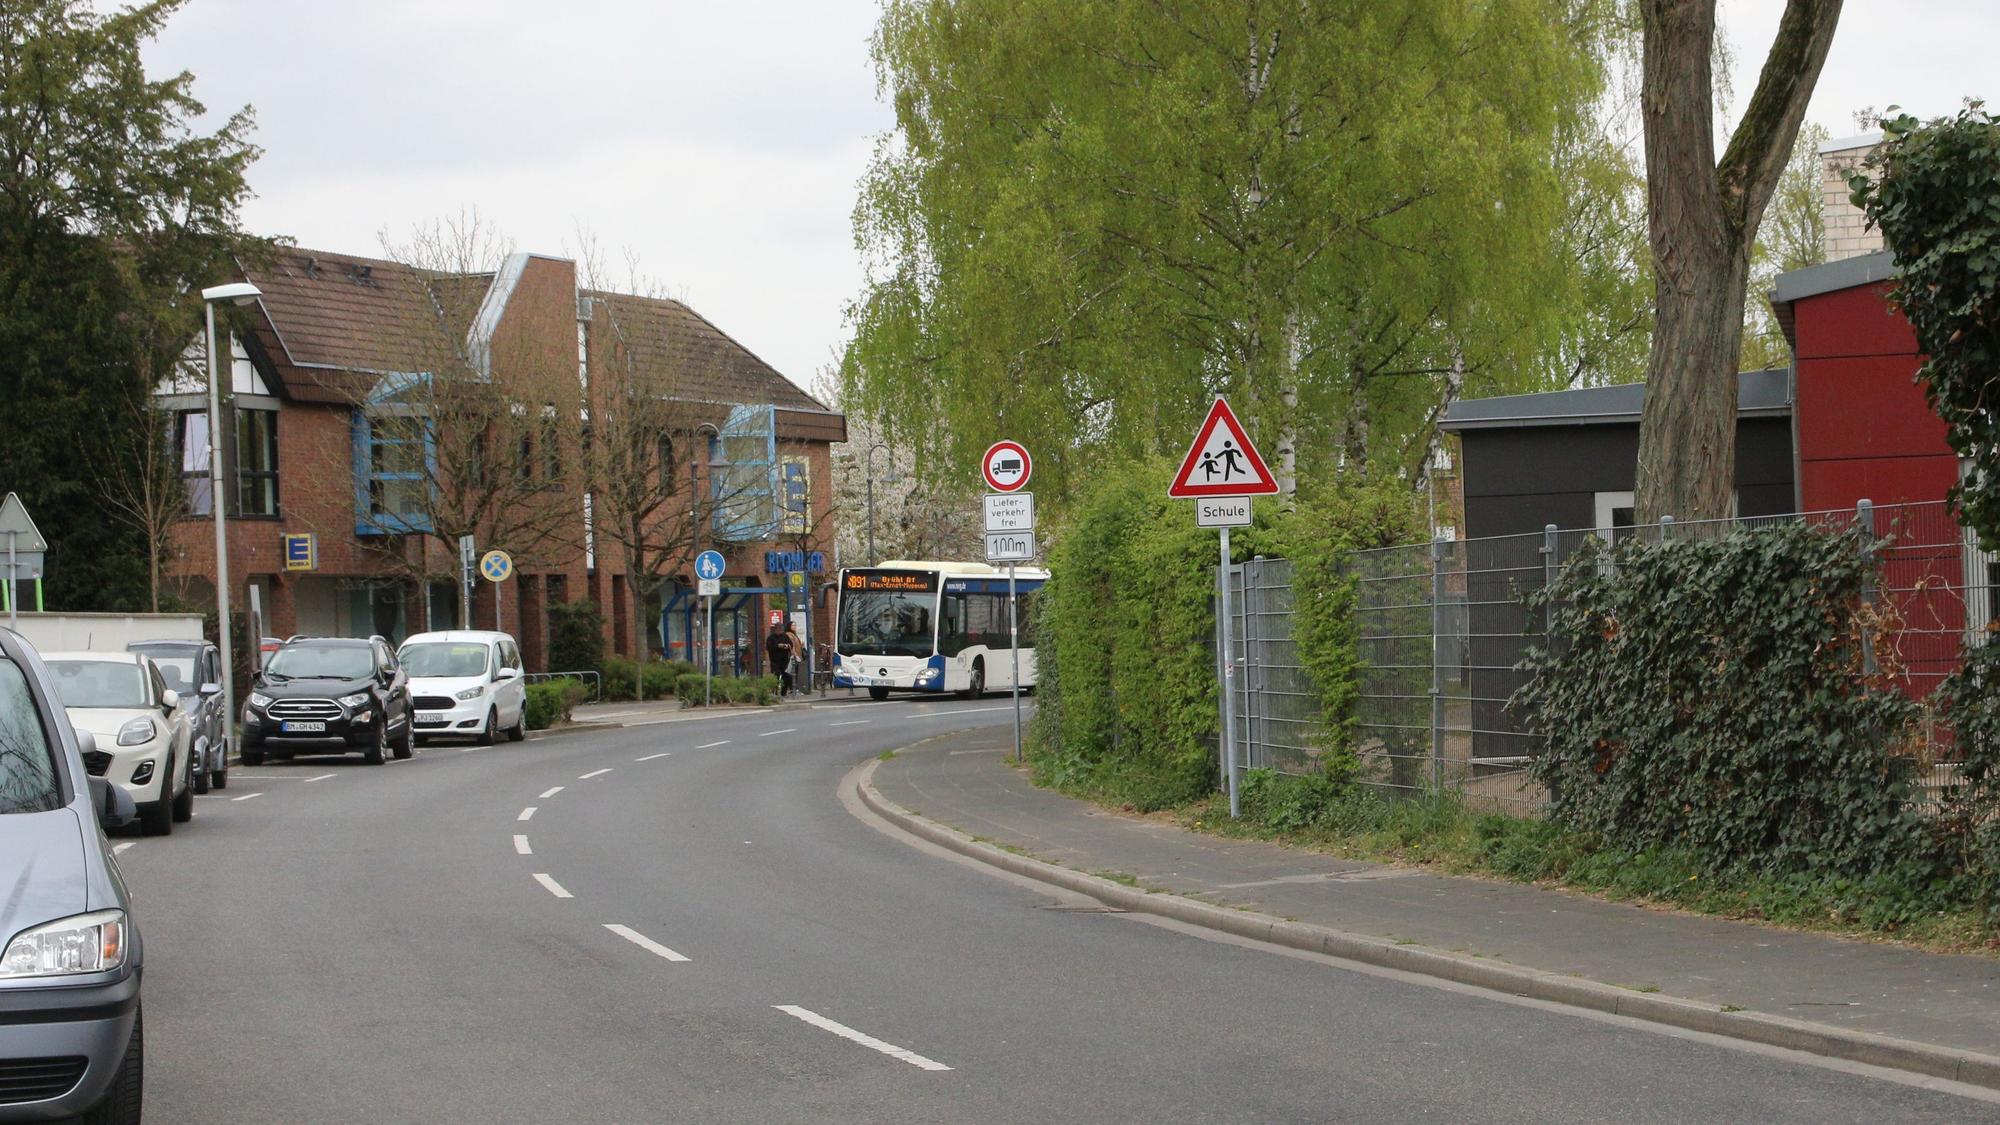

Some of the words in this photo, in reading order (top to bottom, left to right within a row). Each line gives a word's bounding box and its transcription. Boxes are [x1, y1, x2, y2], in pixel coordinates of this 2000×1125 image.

[993, 498, 1023, 507] Liefer-
[991, 508, 1025, 517] verkehr
[1203, 505, 1245, 518] Schule
[1001, 518, 1017, 527] frei
[993, 537, 1026, 556] 100m
